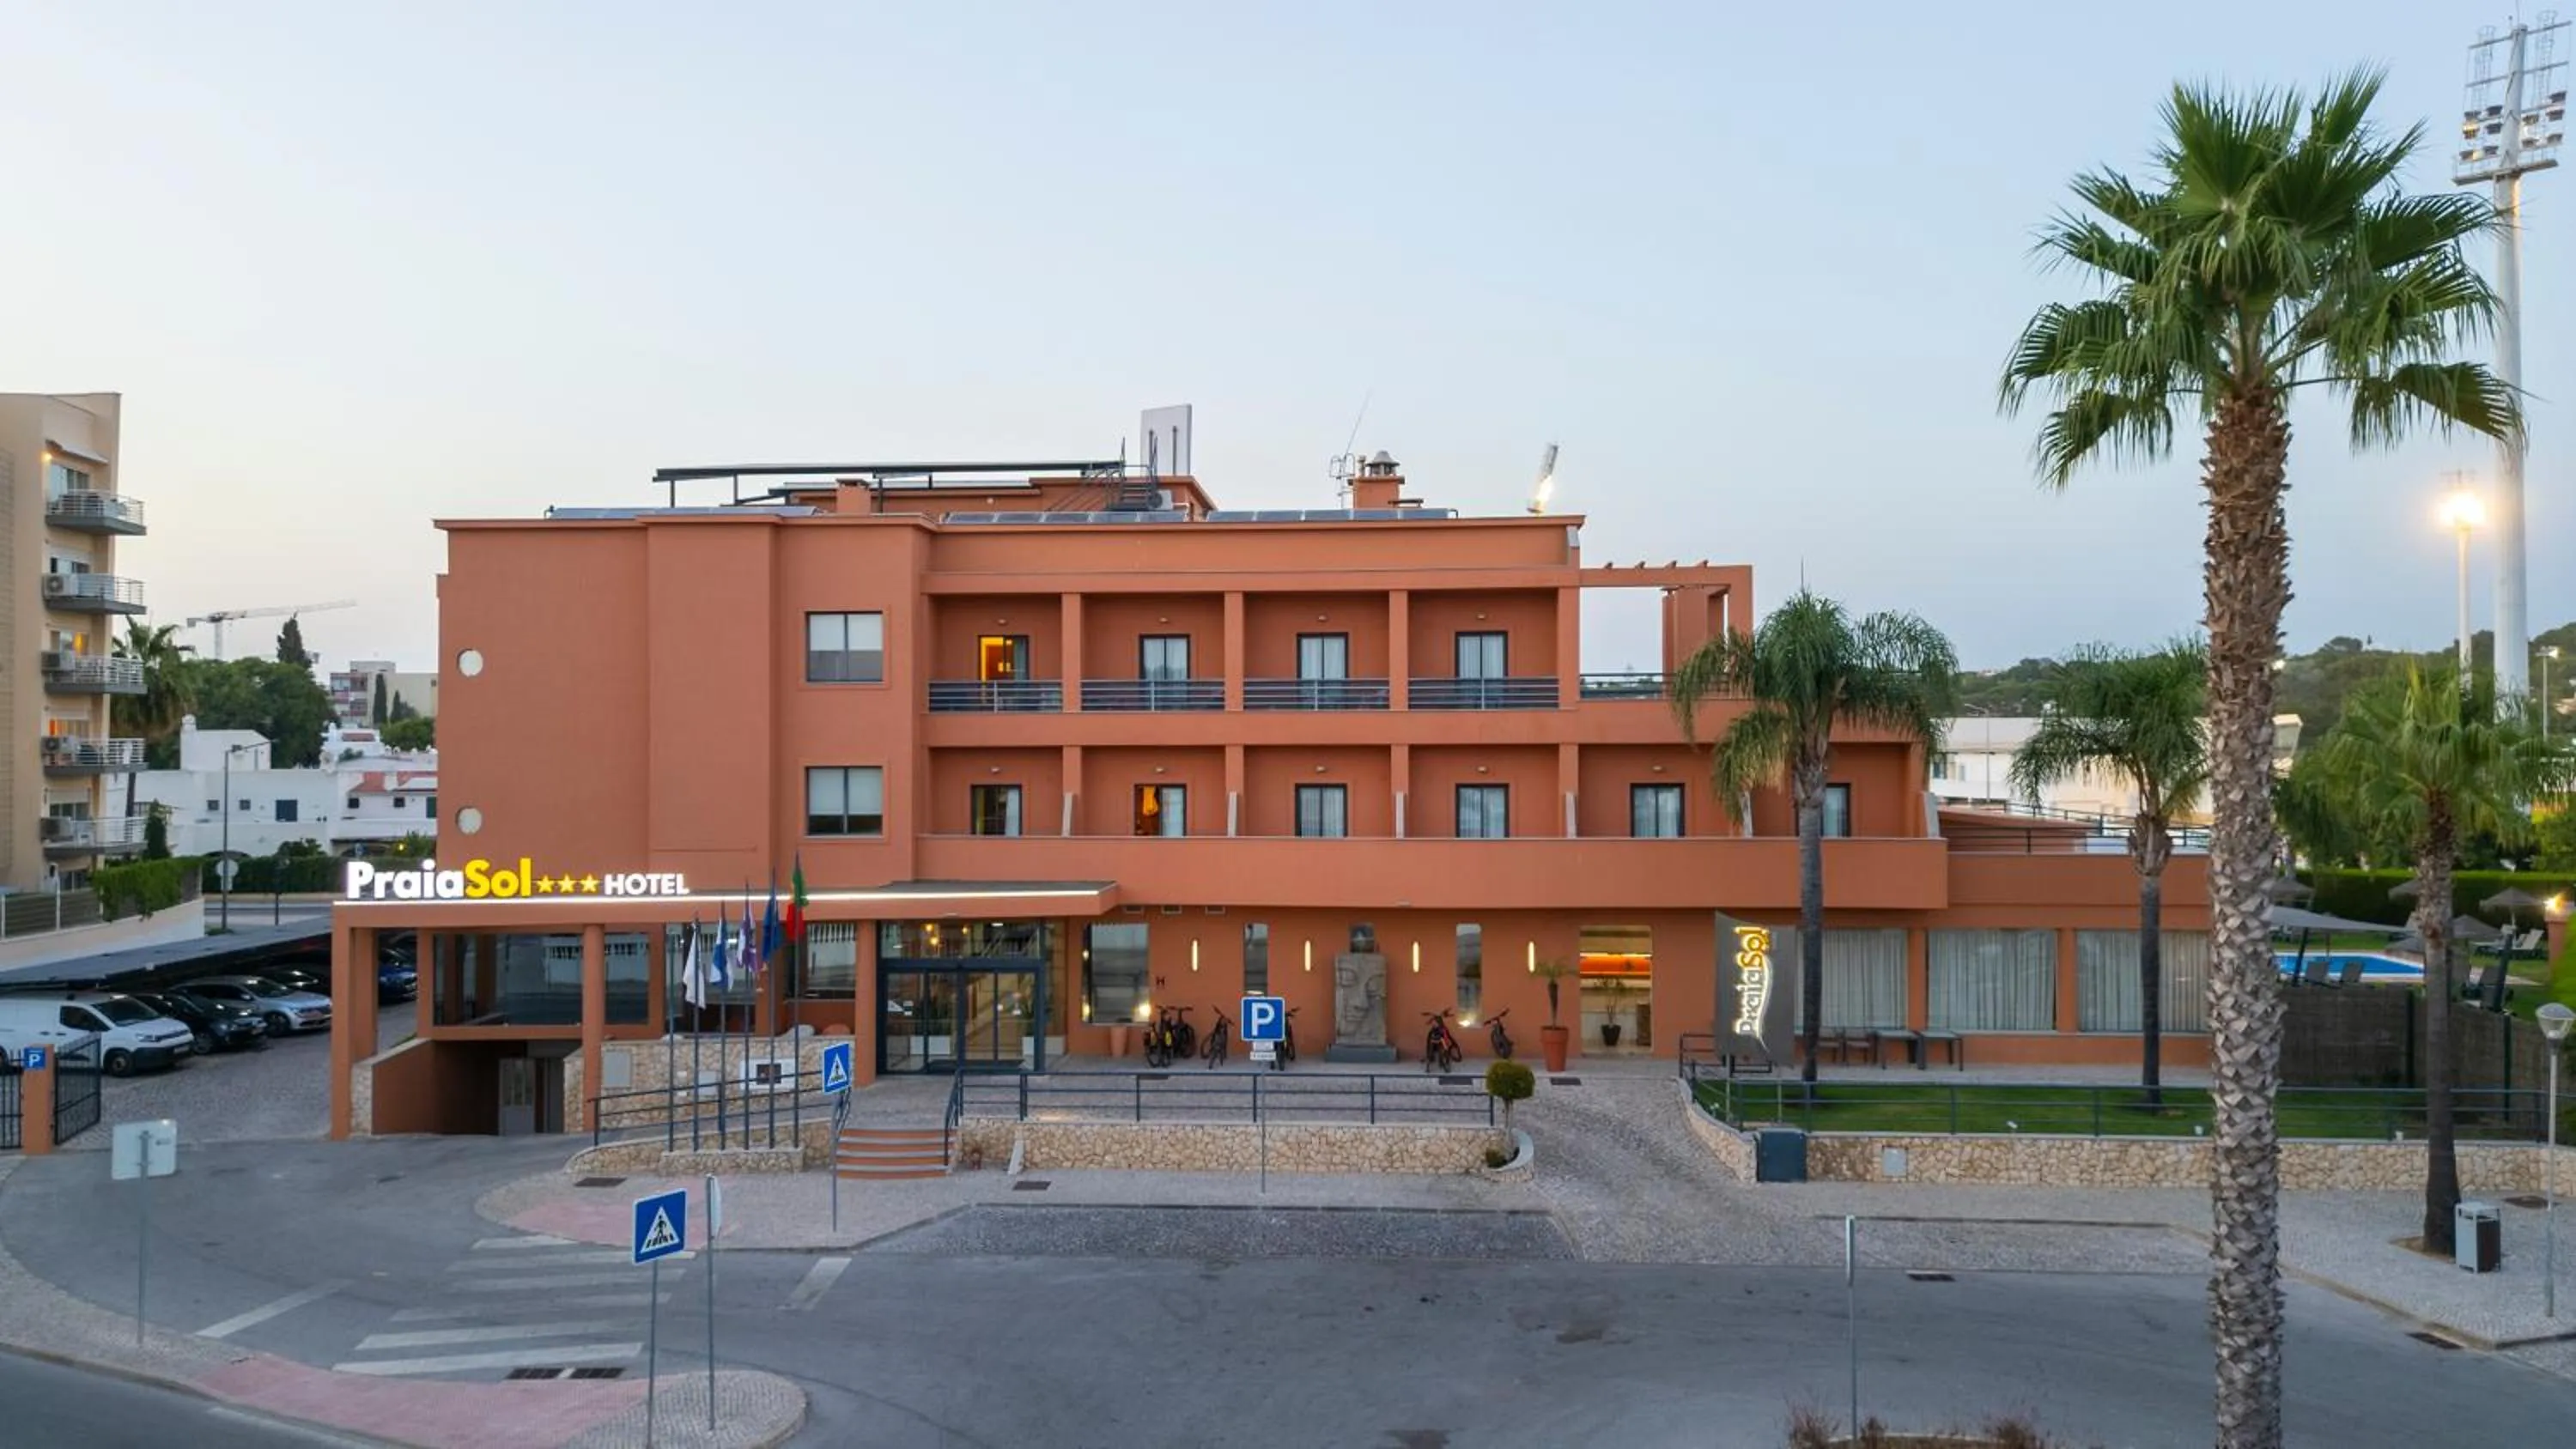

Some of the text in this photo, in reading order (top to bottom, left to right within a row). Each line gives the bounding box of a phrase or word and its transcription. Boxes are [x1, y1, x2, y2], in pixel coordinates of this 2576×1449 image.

[346, 858, 690, 899] PraiaSol HOTEL
[1735, 926, 1769, 1035] PraiaSol
[1251, 1002, 1275, 1037] P
[28, 1053, 41, 1068] P
